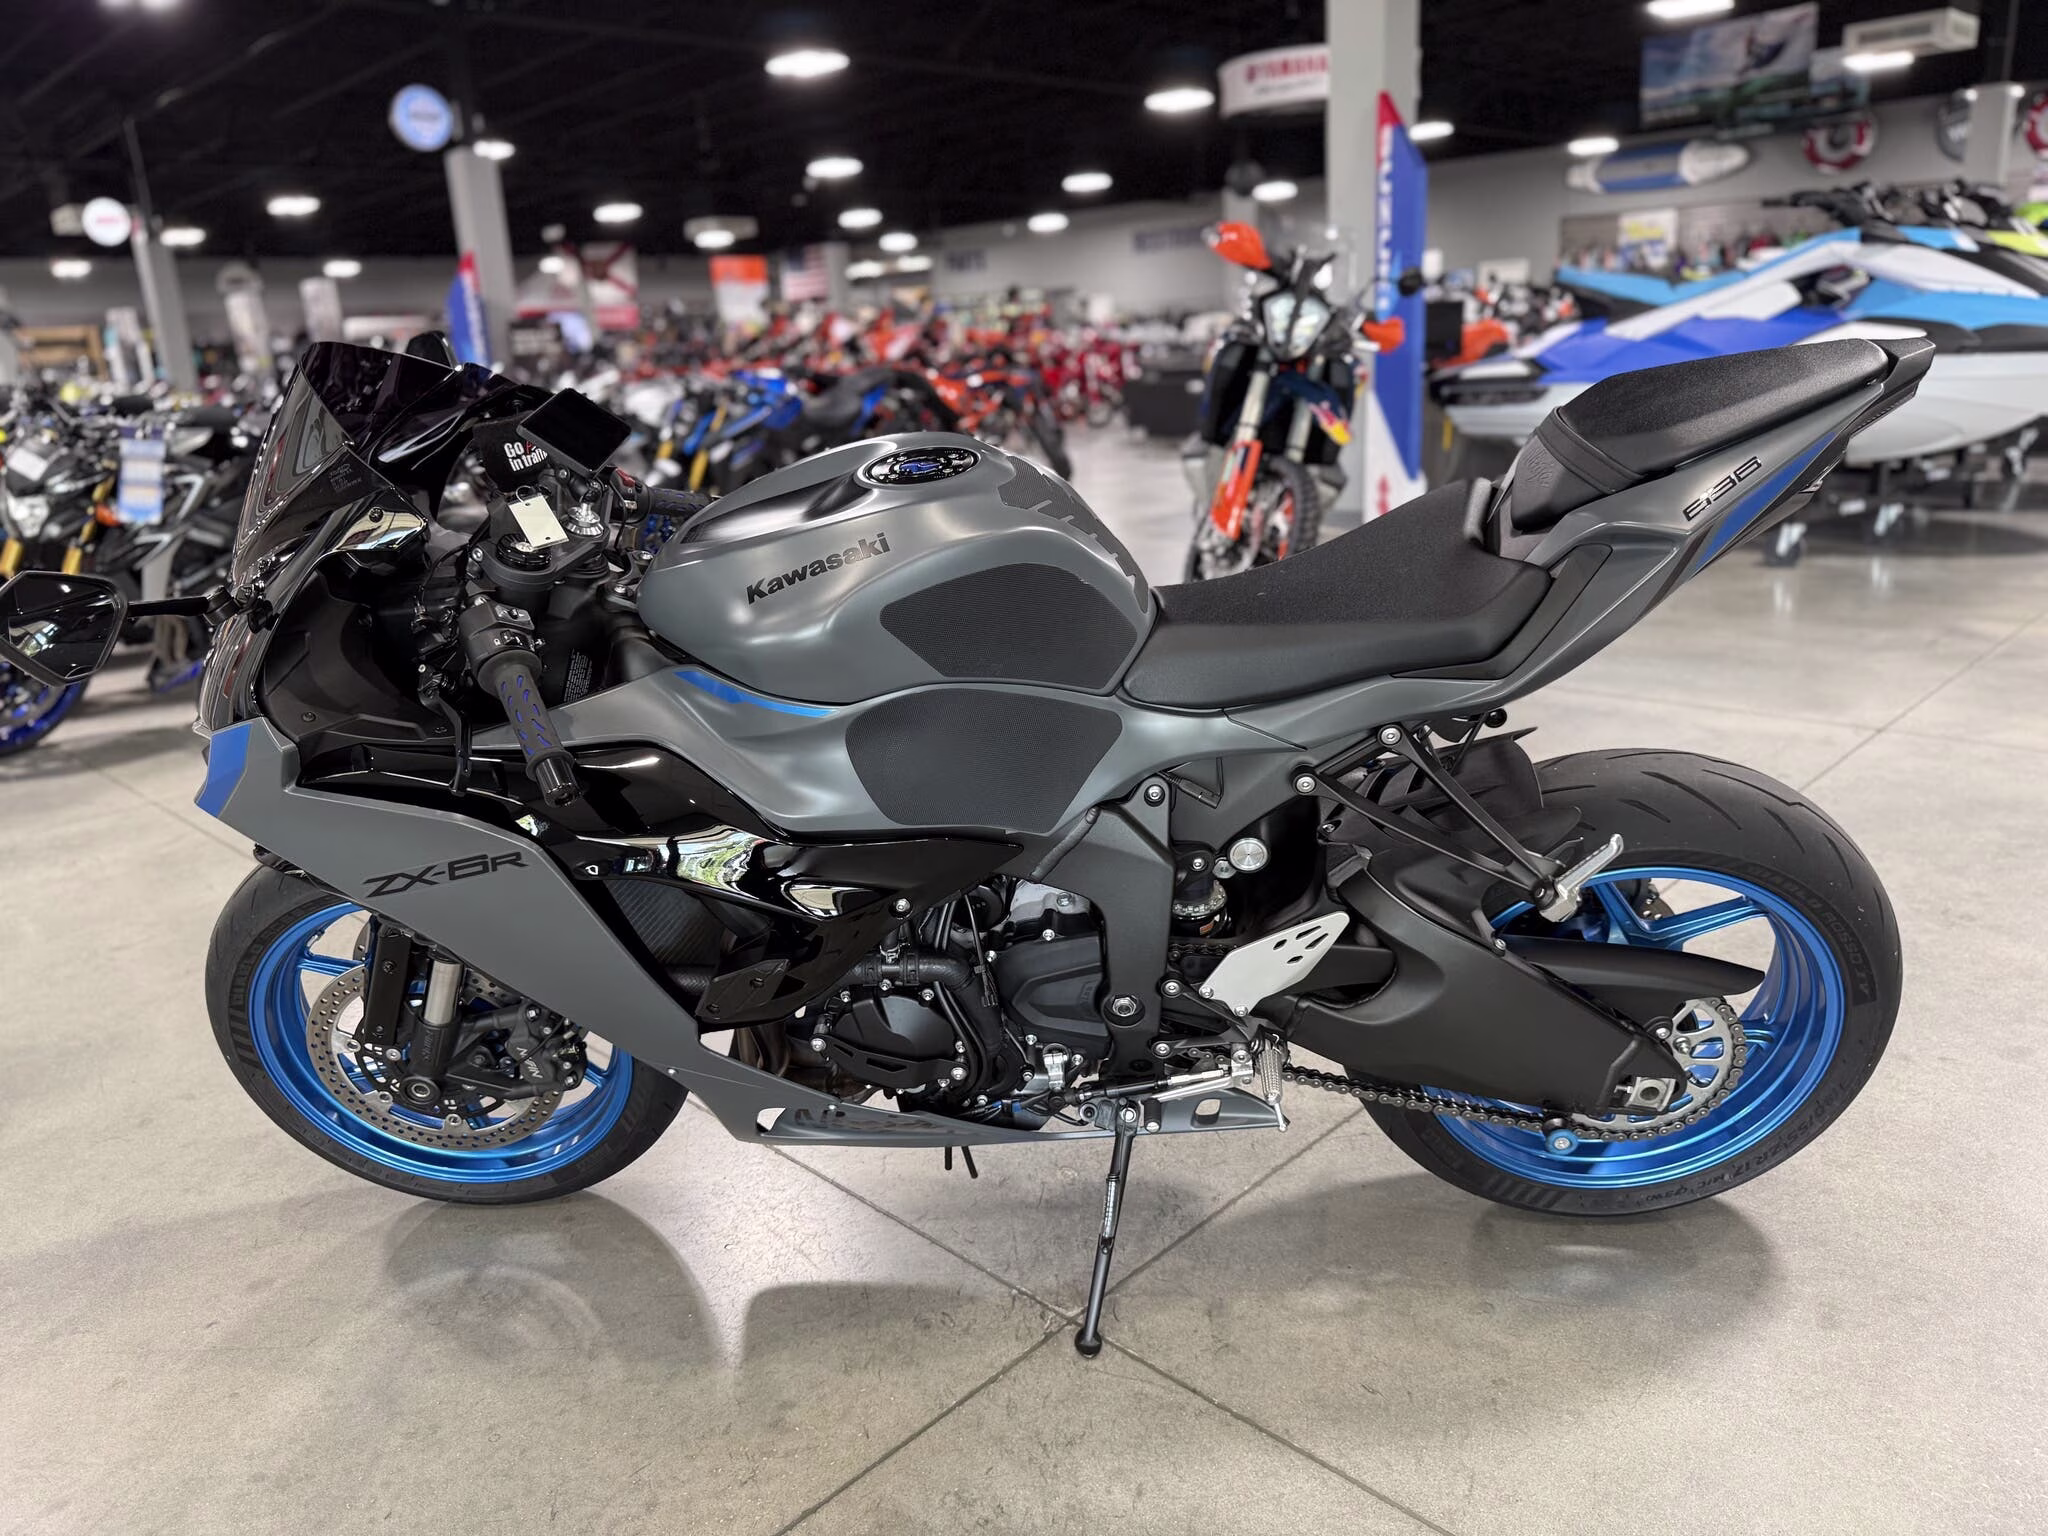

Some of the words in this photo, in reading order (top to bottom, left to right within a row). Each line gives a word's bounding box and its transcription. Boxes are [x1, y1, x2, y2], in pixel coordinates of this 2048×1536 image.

[509, 458, 524, 472] in
[1682, 456, 1762, 521] 636
[746, 532, 891, 605] Kawasaki
[362, 851, 529, 898] ZX-6R
